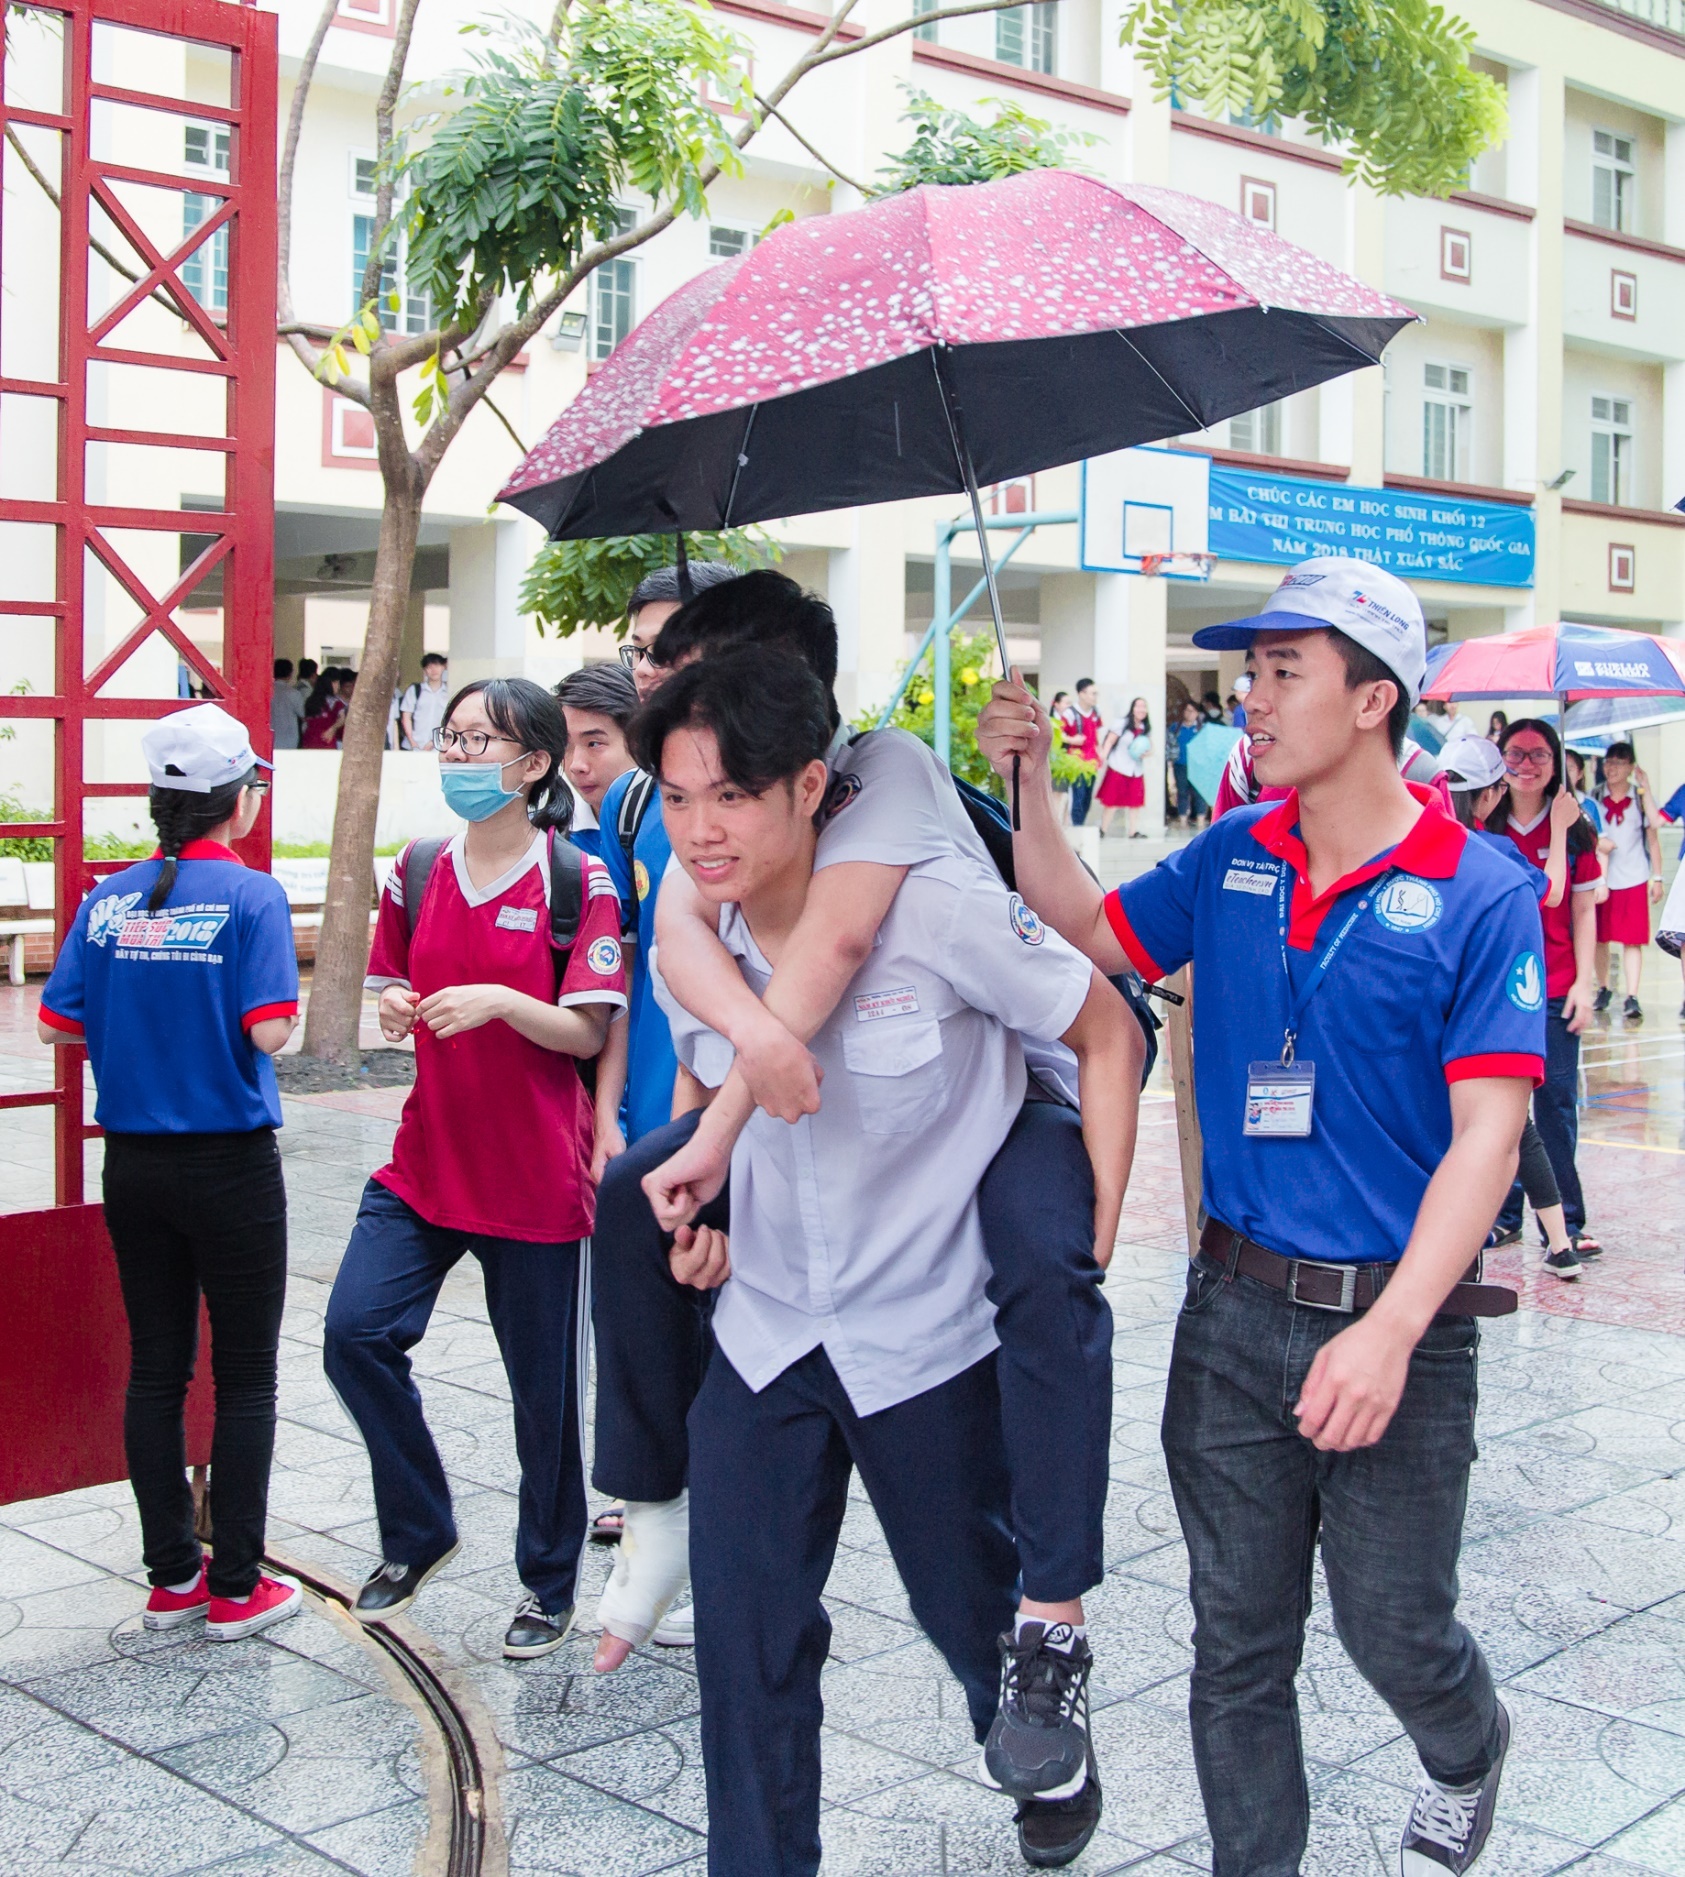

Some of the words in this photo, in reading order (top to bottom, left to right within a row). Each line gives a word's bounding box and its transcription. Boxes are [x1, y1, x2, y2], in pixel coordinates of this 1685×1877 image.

[1247, 486, 1291, 504] CHÚC
[1296, 491, 1327, 509] CÁC
[1332, 497, 1355, 513] EM
[1360, 501, 1389, 517] HỌC
[1395, 505, 1427, 521] SINH
[1432, 508, 1466, 526] KHỐI
[1471, 515, 1486, 529] 12
[1228, 506, 1257, 525] BÀI
[1262, 512, 1289, 530] THI
[1294, 517, 1346, 535] TRUNG
[1351, 523, 1381, 539] HỌC
[1419, 530, 1465, 549] THÔNG
[1469, 534, 1505, 554] QUỐC
[1508, 542, 1531, 556] GIA
[1312, 543, 1349, 557] 2018
[1396, 549, 1434, 568] XUẤT
[1390, 613, 1410, 631] LONG
[166, 920, 218, 942] 2018
